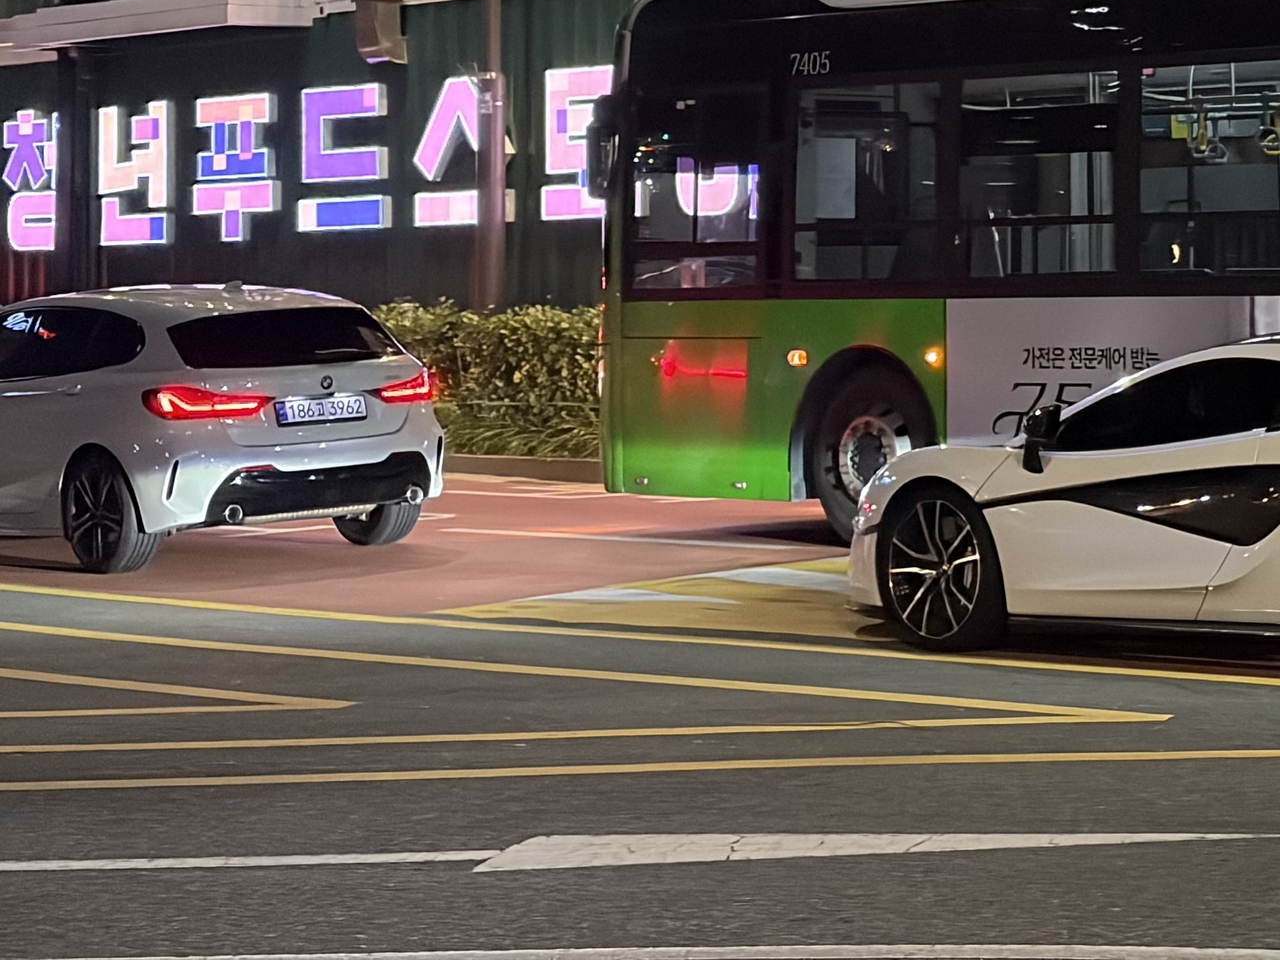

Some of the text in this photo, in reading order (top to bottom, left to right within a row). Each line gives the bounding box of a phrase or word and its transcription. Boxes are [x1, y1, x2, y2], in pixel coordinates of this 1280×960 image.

[790, 51, 831, 76] 7405
[1022, 346, 1066, 369] 가전은
[1068, 346, 1127, 370] 전문케어
